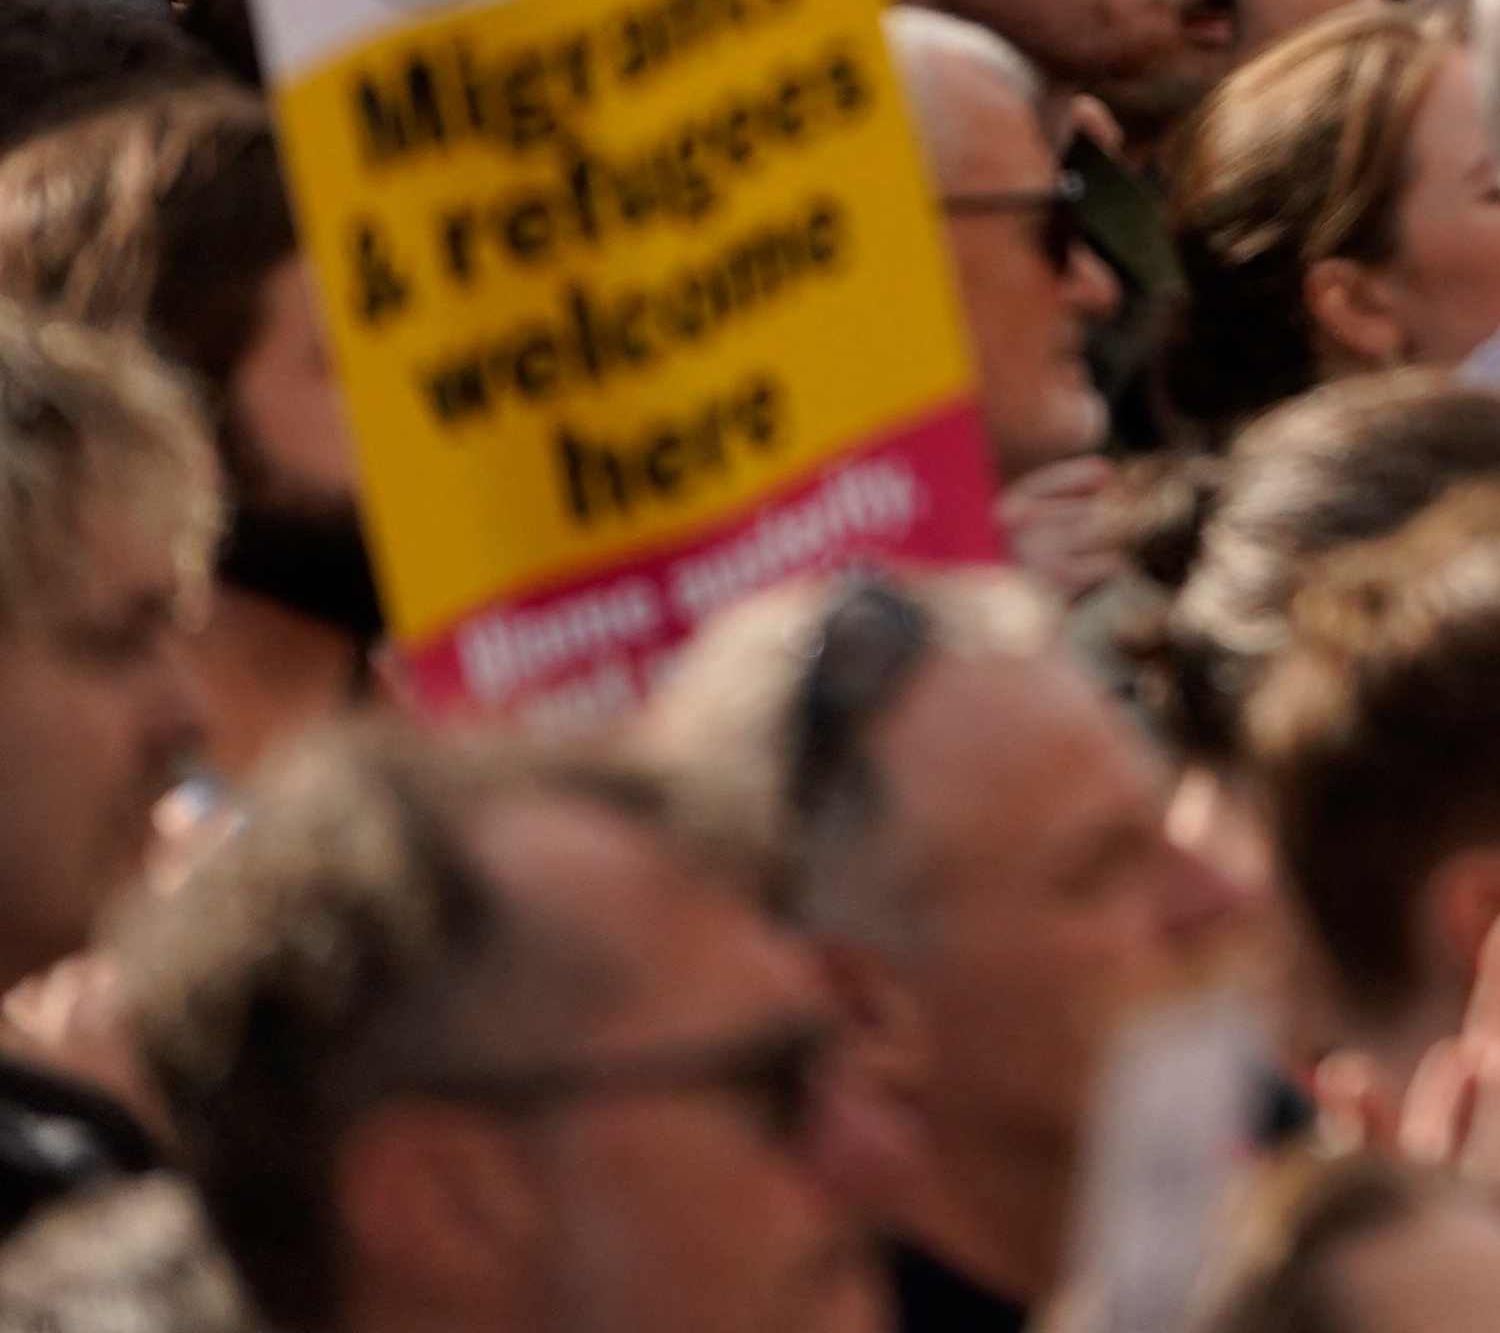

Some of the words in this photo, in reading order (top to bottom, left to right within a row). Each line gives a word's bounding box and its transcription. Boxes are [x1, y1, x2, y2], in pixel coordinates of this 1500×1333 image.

[353, 220, 412, 326] &
[440, 37, 875, 287] refugees
[421, 199, 842, 427] welcome
[553, 371, 780, 523] here
